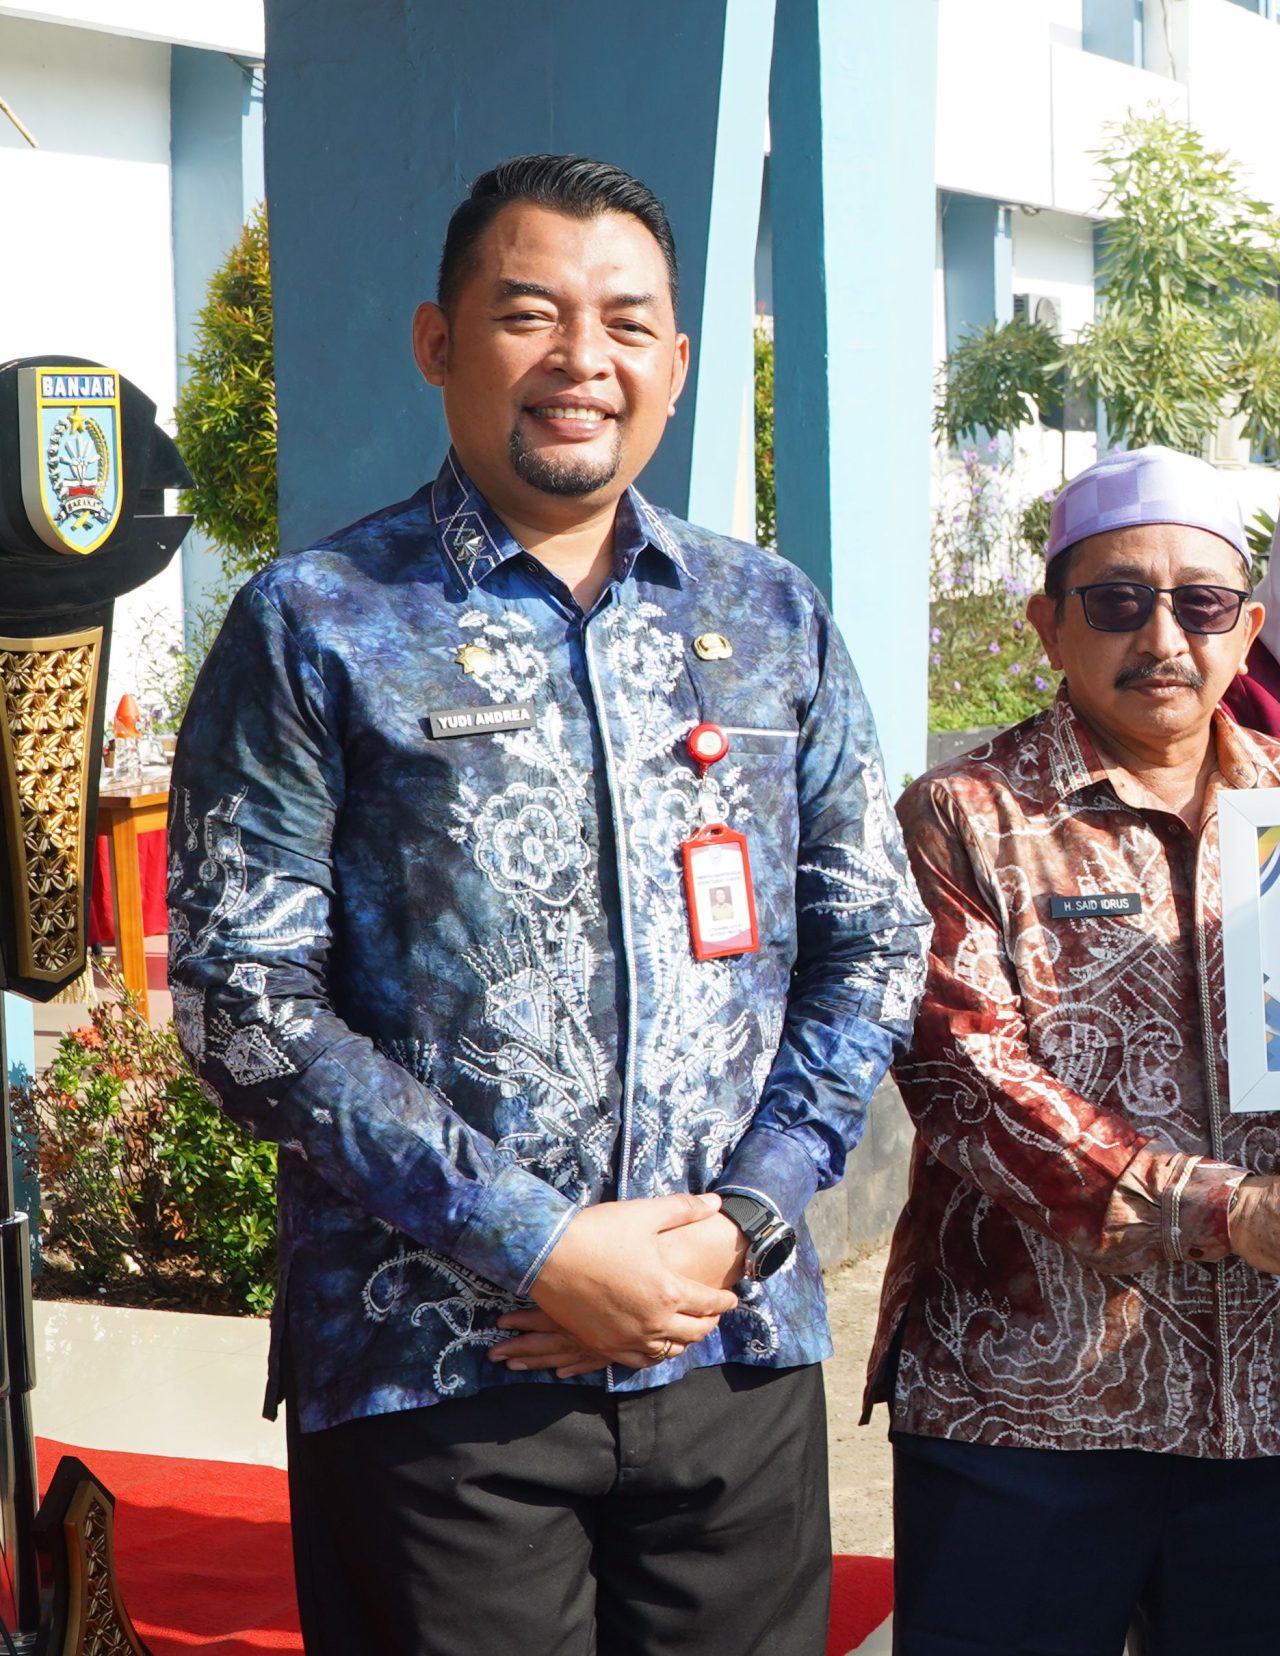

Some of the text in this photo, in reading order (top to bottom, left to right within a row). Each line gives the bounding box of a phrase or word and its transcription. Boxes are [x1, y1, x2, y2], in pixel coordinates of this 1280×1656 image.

[42, 376, 115, 398] BANJAR
[438, 708, 530, 729] YUDI ANDREA
[1101, 898, 1129, 910] IDRUS
